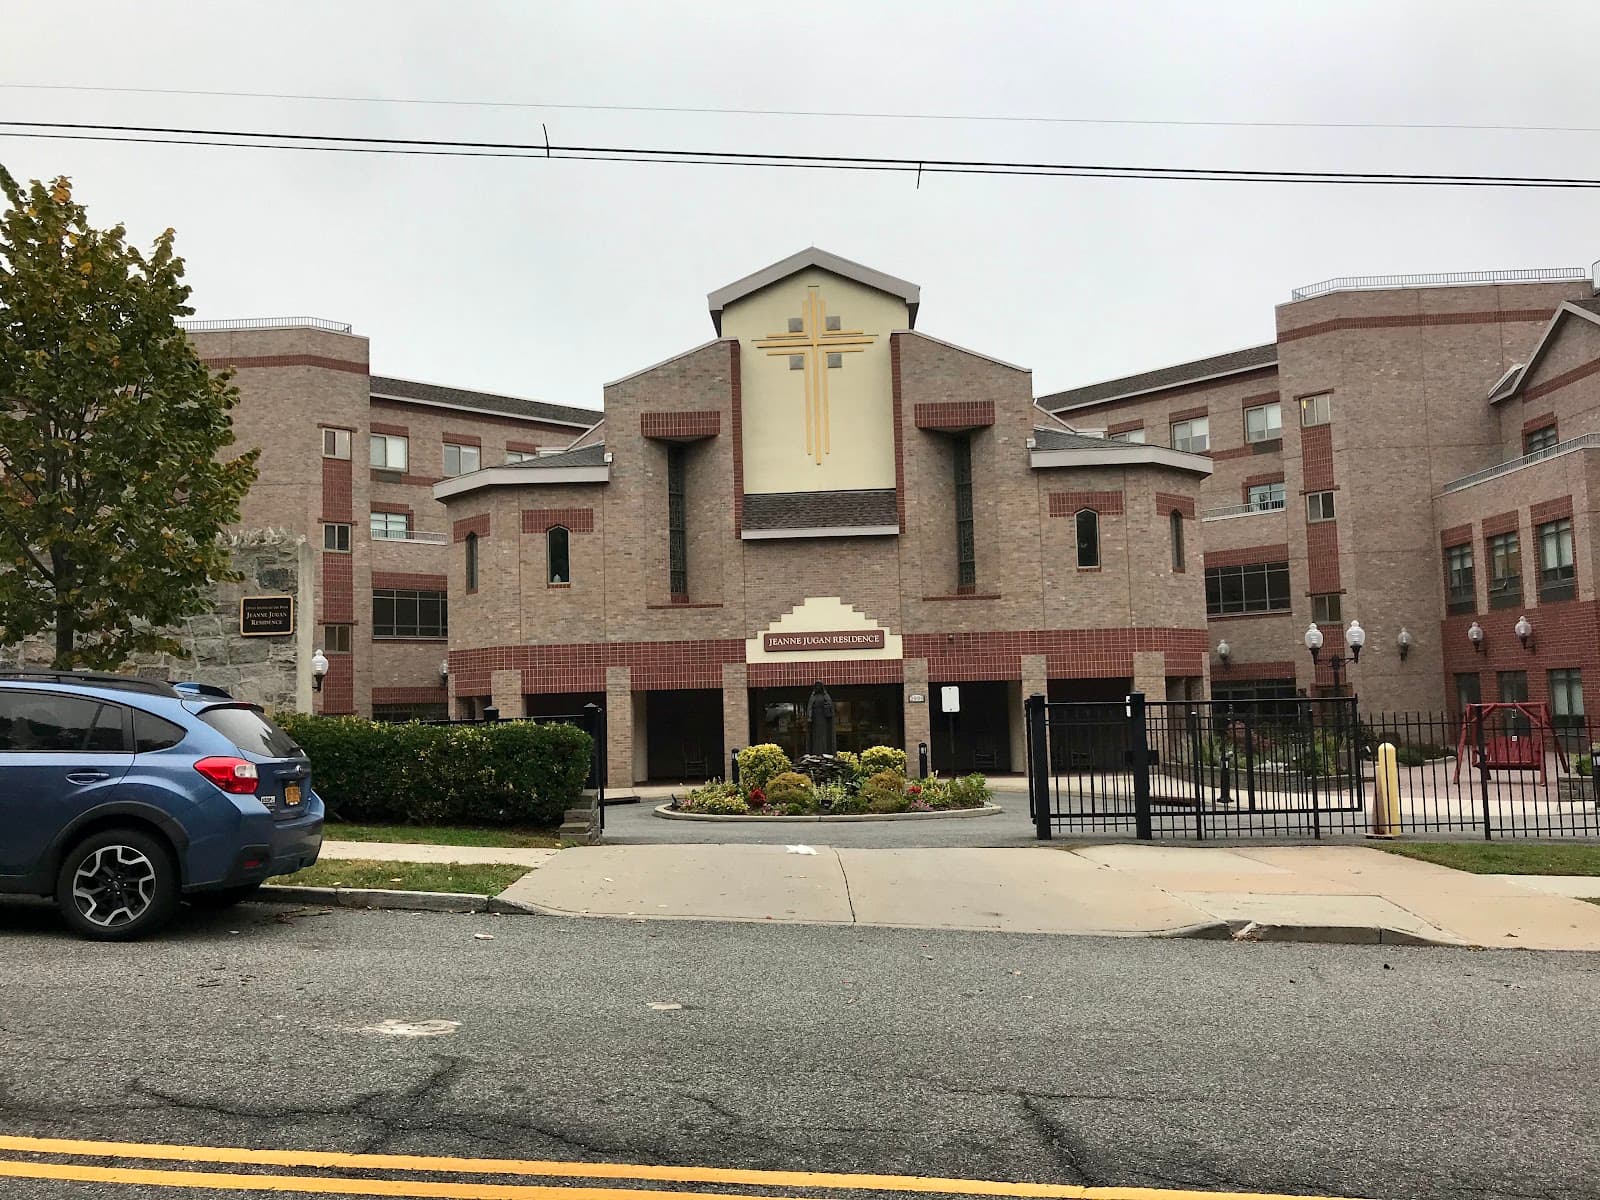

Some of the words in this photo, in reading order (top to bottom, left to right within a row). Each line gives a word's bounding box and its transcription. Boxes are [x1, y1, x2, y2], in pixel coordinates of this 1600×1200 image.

[768, 637, 801, 647] JEANNE
[803, 636, 831, 646] JUGAN
[832, 635, 880, 644] RESIDENCE
